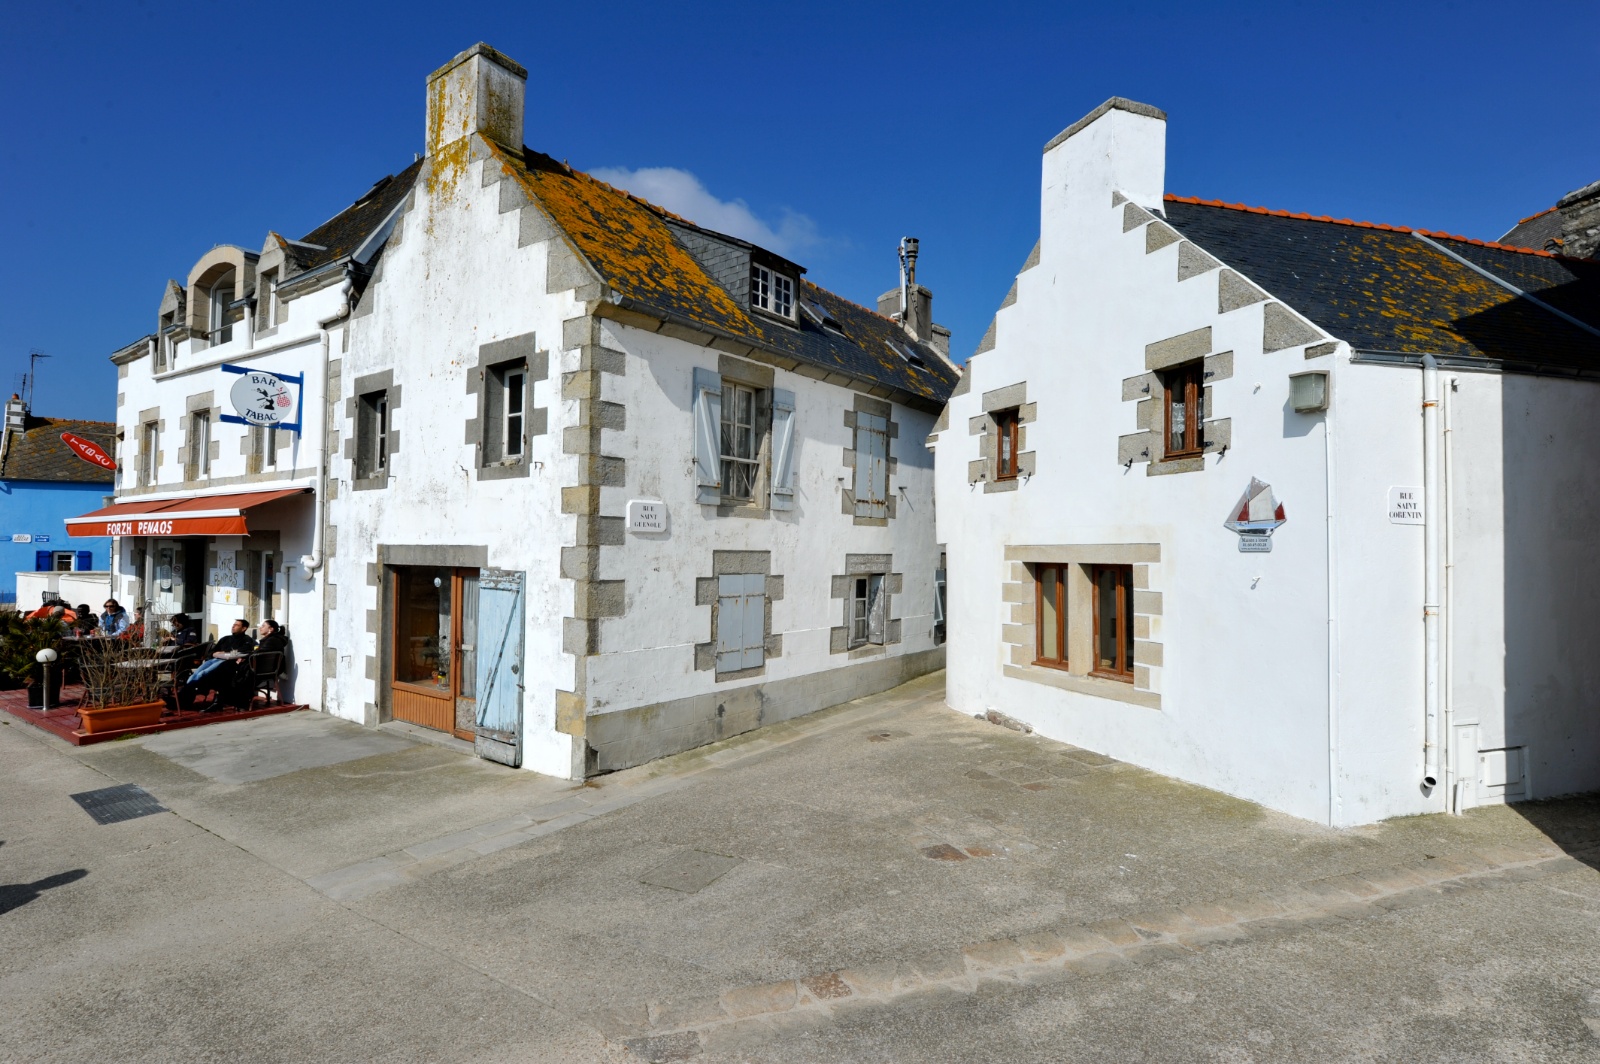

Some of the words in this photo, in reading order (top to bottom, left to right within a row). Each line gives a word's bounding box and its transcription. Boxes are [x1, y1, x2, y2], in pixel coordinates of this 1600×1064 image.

[252, 376, 276, 387] BAR
[245, 408, 277, 421] TABAC
[70, 437, 110, 465] TABAC
[106, 522, 132, 535] FORZH
[138, 520, 173, 534] PENAOS
